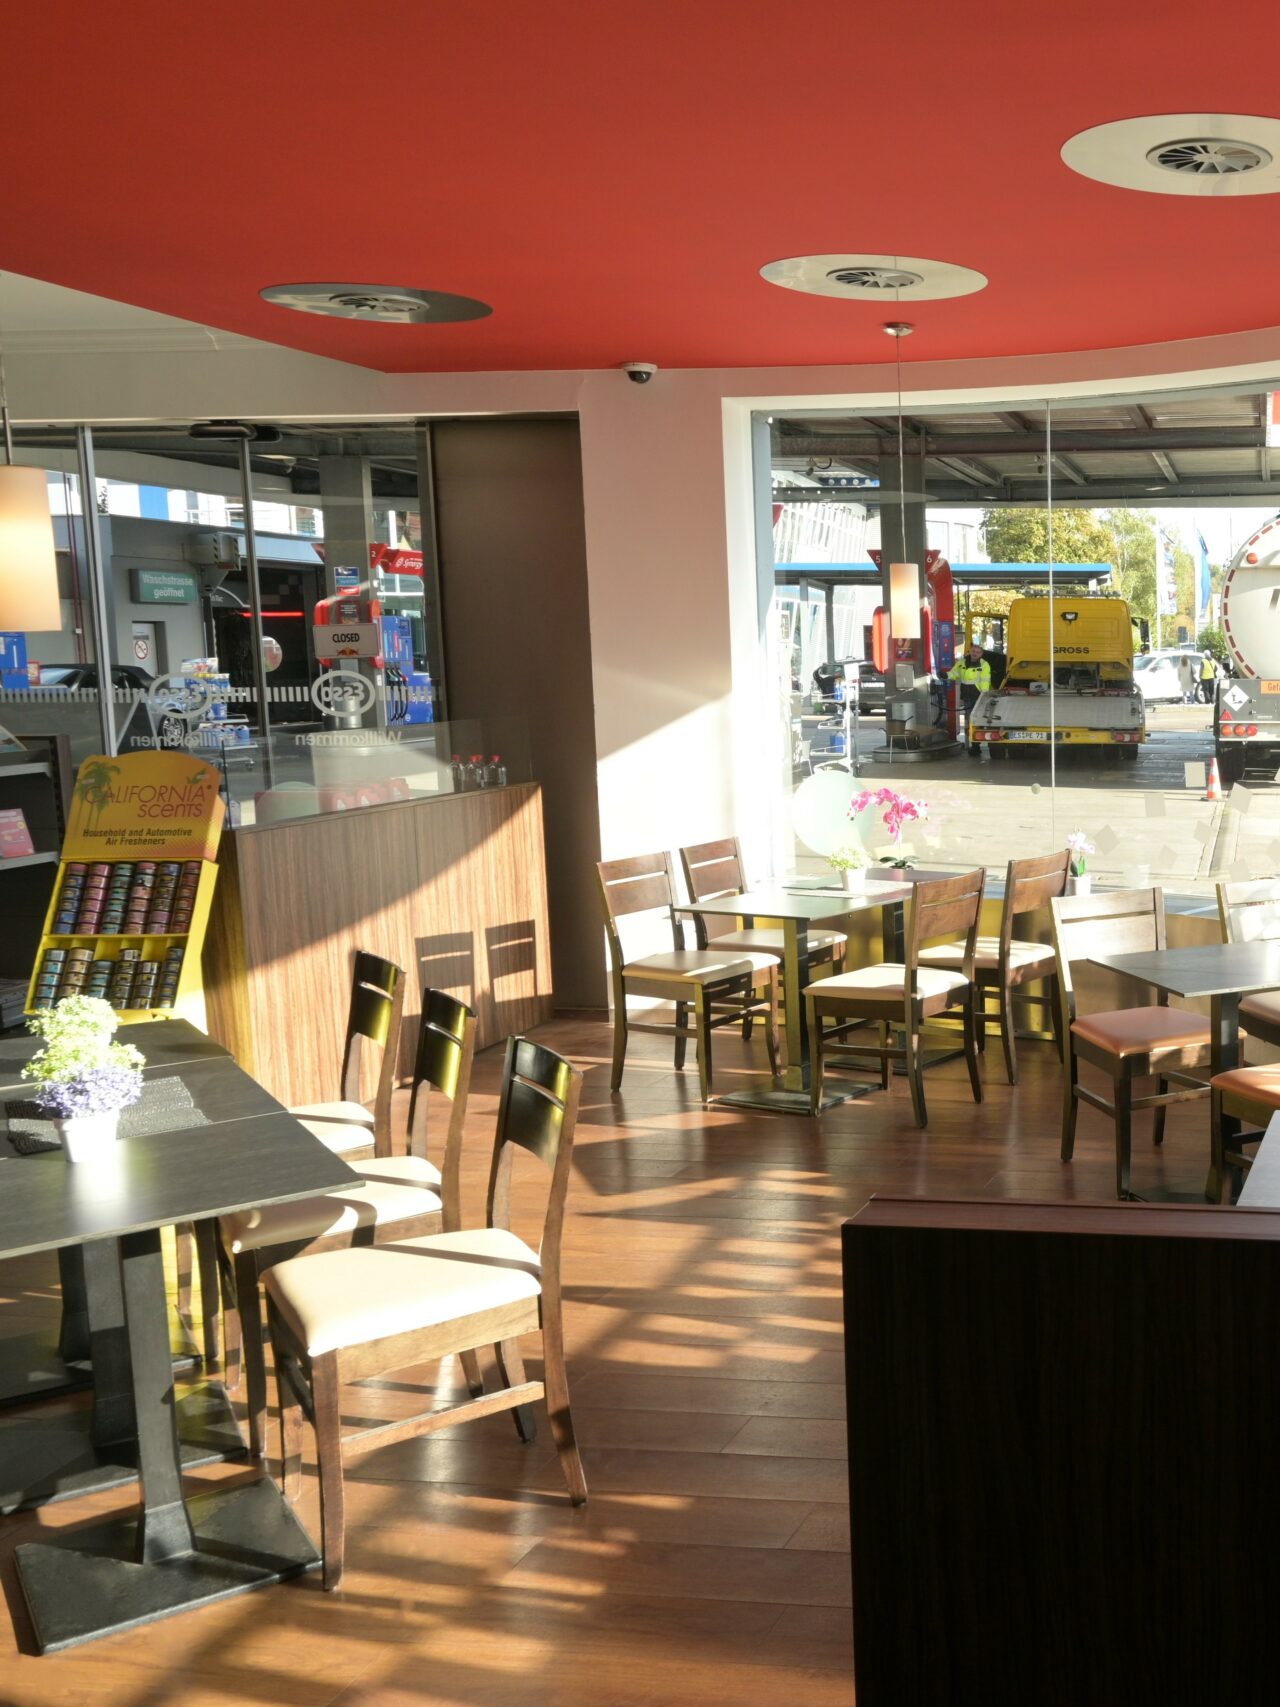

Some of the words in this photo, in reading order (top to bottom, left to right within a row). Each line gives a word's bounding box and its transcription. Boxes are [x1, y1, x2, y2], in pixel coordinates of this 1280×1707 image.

[142, 573, 194, 587] Waschstrasse
[153, 587, 186, 600] geöffnet
[332, 632, 360, 644] CLOSED
[1052, 646, 1090, 655] GROSS
[84, 785, 206, 804] CALIFORNIA
[136, 803, 203, 819] scents
[83, 828, 126, 838] Household
[128, 828, 144, 837] and
[146, 827, 193, 838] Automotive
[105, 837, 119, 847] Air
[120, 837, 166, 847] Fresheners
